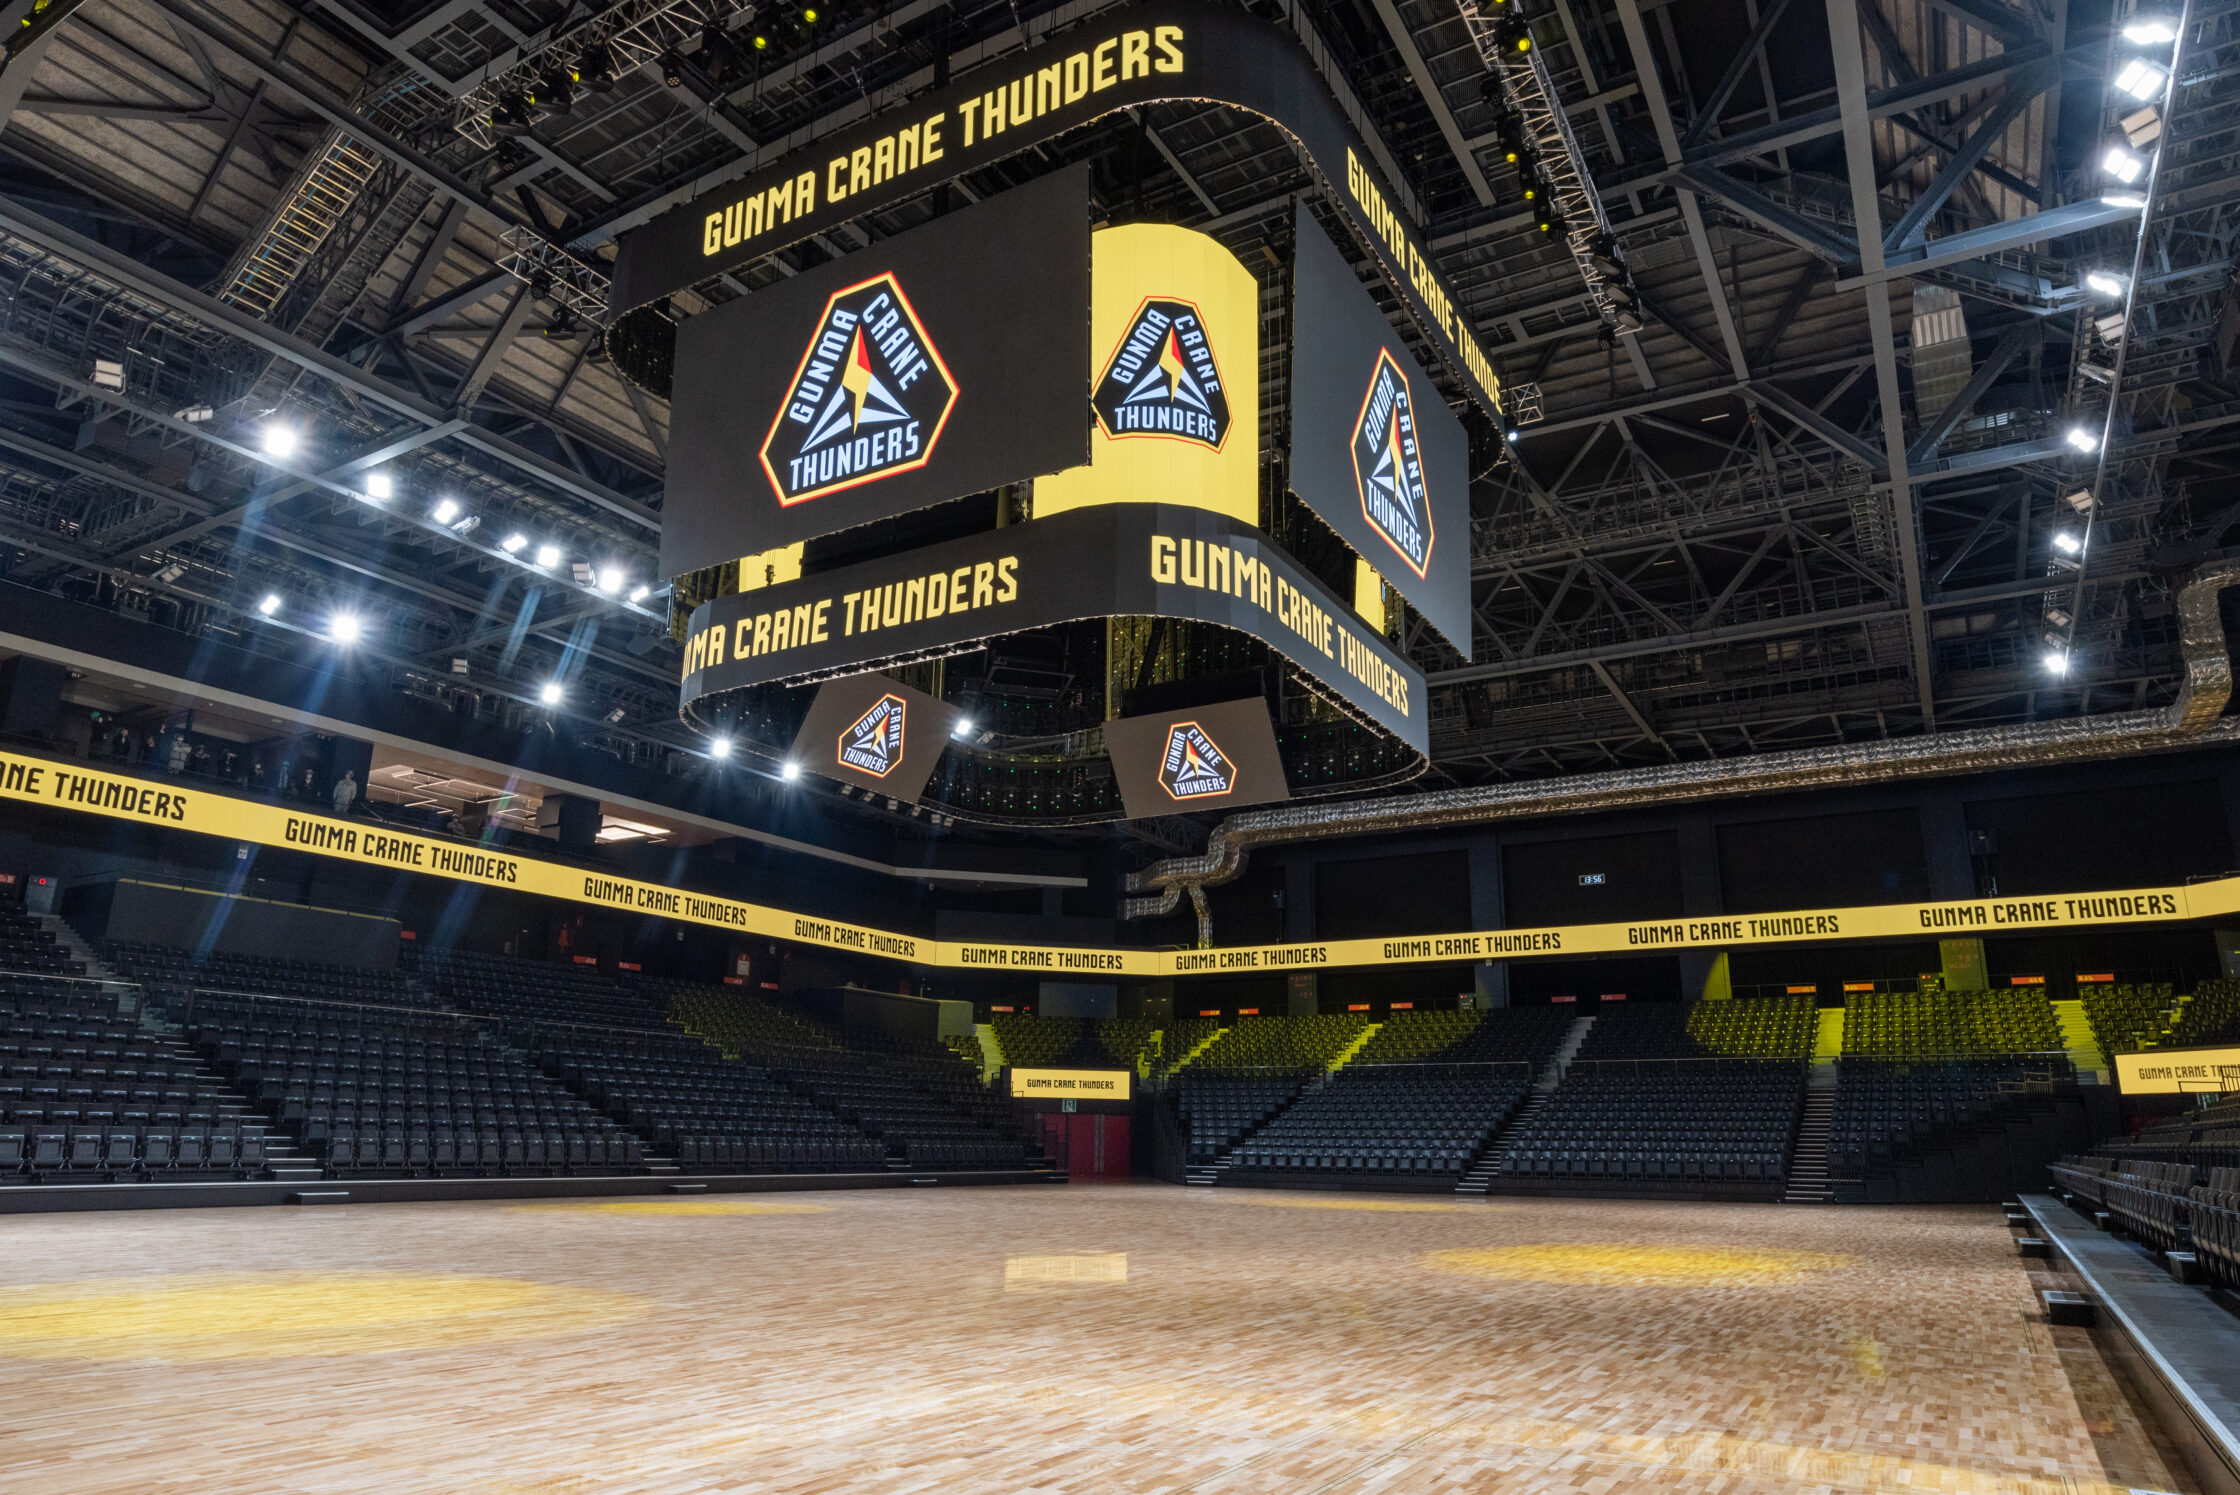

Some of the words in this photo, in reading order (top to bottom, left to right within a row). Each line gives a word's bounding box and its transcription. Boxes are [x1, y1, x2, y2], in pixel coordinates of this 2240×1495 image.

[703, 171, 816, 256] GUNMA
[826, 113, 946, 203] CRANE
[958, 26, 1185, 148] THUNDERS
[1347, 146, 1406, 271] GUNMA
[1408, 240, 1454, 344] CRANE
[862, 292, 928, 391] CRANE
[1111, 308, 1171, 384] GUNMA
[1174, 314, 1220, 394] CRANE
[789, 308, 858, 424] GUNMA
[1114, 405, 1217, 442] THUNDERS
[1364, 366, 1395, 454] GUNMA
[790, 421, 919, 491] THUNDERS
[1395, 391, 1424, 500] CRANE
[1367, 478, 1422, 564] THUNDERS
[734, 598, 833, 660] CRANE
[843, 555, 1019, 636] THUNDERS
[1151, 535, 1272, 614] GUNMA
[1277, 575, 1334, 660] CRANE
[1337, 624, 1409, 718] THUNDERS
[854, 700, 891, 738] GUNMA
[889, 706, 902, 749] CRANE
[843, 747, 889, 773] THUNDERS
[1166, 730, 1187, 772] GUNMA
[1187, 728, 1222, 767] CRANE
[55, 772, 187, 821] THUNDERS
[1173, 777, 1227, 796] THUNDERS
[285, 818, 357, 853] GUNMA
[363, 834, 424, 865] CRANE
[431, 847, 518, 883] THUNDERS
[584, 877, 633, 905] GUNMA
[638, 888, 680, 914] CRANE
[685, 898, 747, 926] THUNDERS
[1920, 906, 1987, 928] GUNMA
[1994, 901, 2059, 923] CRANE
[2064, 894, 2177, 919] THUNDERS
[795, 919, 831, 941] GUNMA
[834, 928, 866, 948] CRANE
[868, 934, 915, 957] THUNDERS
[1384, 941, 1431, 959] GUNMA
[1435, 937, 1480, 956] CRANE
[1485, 933, 1562, 953] THUNDERS
[1628, 924, 1684, 945] GUNMA
[1689, 921, 1743, 942] CRANE
[1748, 915, 1840, 938] THUNDERS
[961, 948, 1007, 964] GUNMA
[1011, 950, 1052, 967] CRANE
[1057, 952, 1123, 970] THUNDERS
[1176, 953, 1216, 971] GUNMA
[1220, 951, 1258, 968] CRANE
[1263, 947, 1327, 965] THUNDERS
[1027, 1079, 1052, 1088] GUNMA
[1054, 1079, 1076, 1089] CRANE
[1079, 1080, 1114, 1090] THUNDERS
[2138, 1066, 2173, 1080] GUNMA
[2174, 1065, 2208, 1078] CRANE
